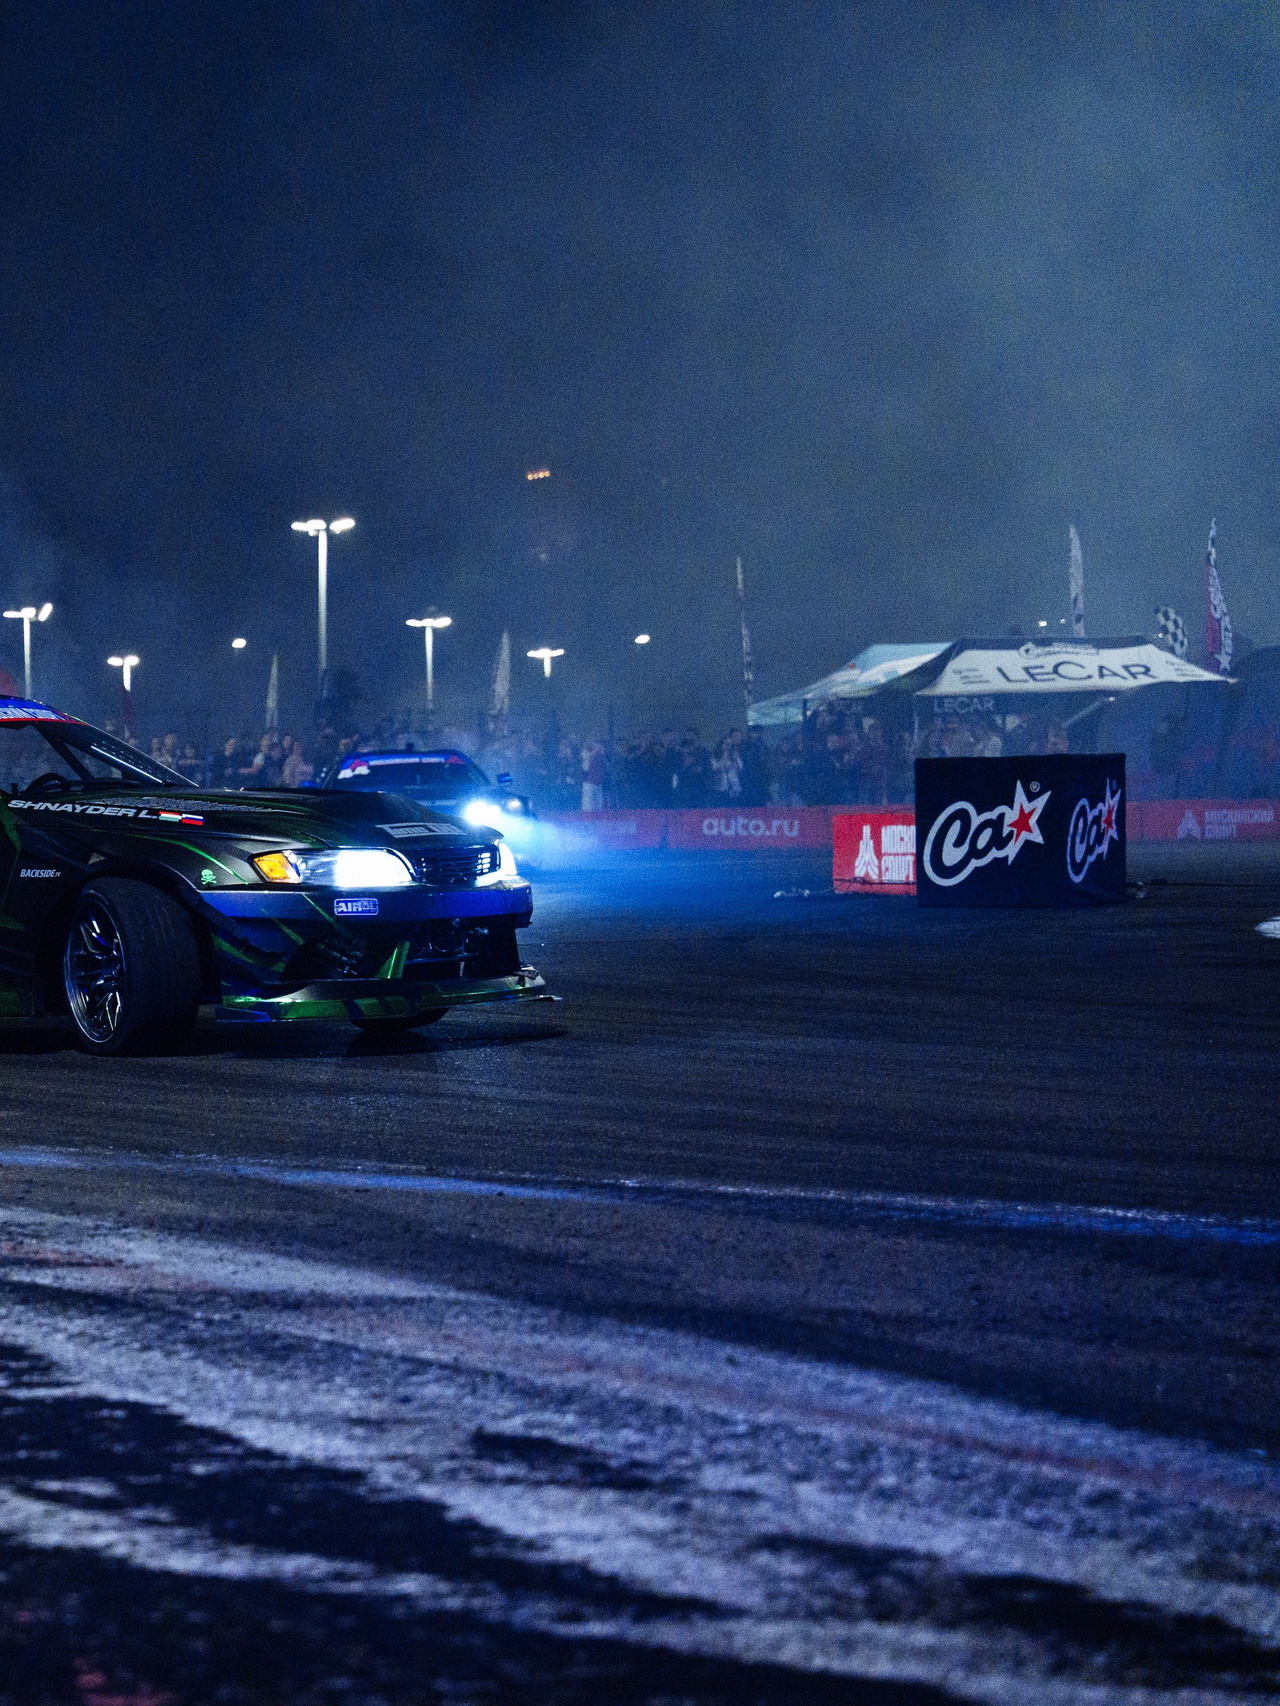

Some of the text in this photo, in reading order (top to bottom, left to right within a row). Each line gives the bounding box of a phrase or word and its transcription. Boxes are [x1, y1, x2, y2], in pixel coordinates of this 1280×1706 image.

[997, 661, 1158, 682] LECAR
[8, 799, 138, 818] SHNAYDER
[703, 815, 799, 837] auto.ru
